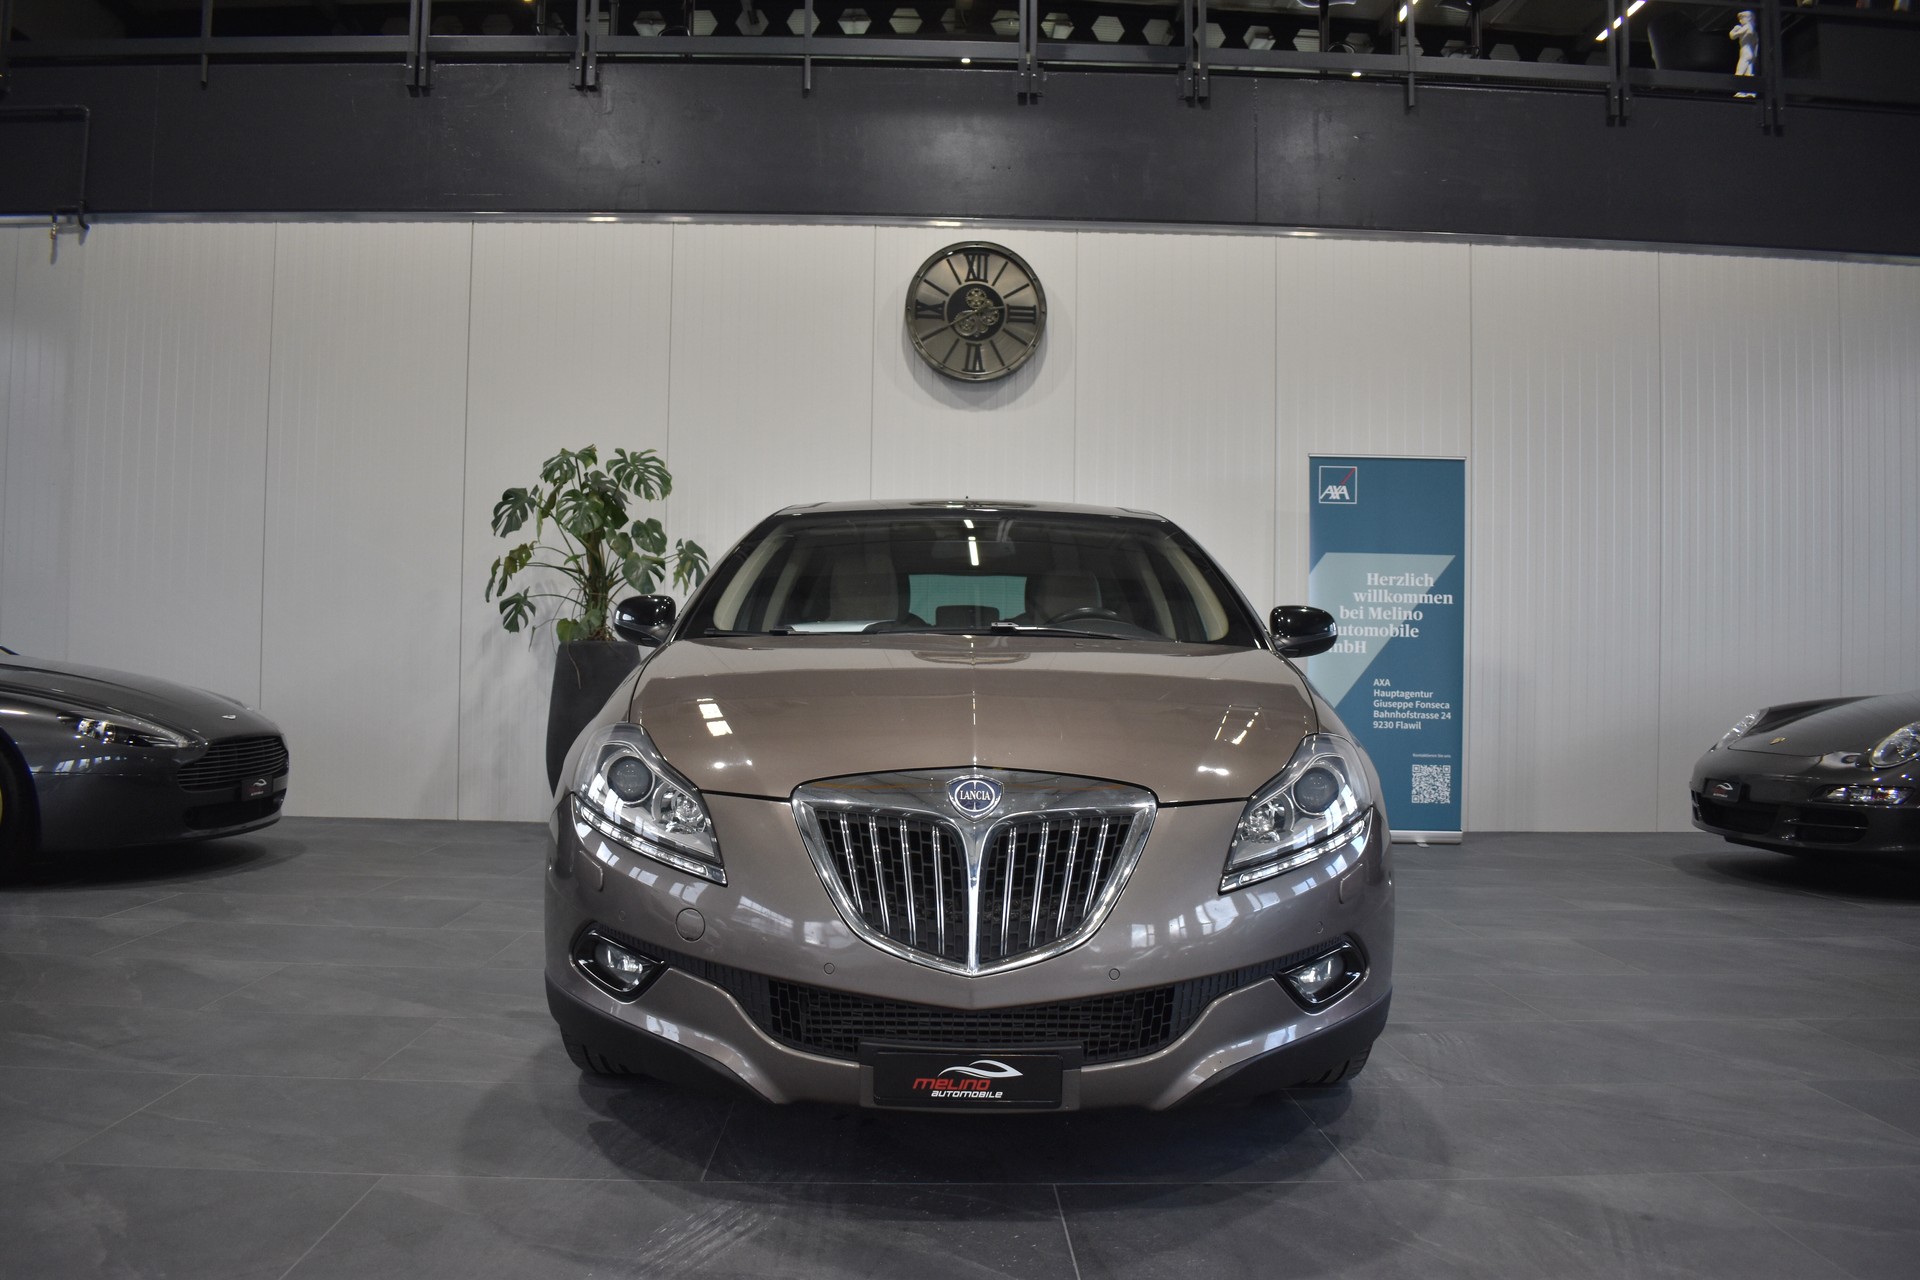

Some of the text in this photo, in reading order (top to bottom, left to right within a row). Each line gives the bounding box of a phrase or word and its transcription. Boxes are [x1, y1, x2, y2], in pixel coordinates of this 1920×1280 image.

[1320, 485, 1350, 500] AXA
[1366, 573, 1434, 587] Herzlich
[1353, 590, 1453, 604] willkommen
[1339, 606, 1423, 621] bei Melino
[1337, 623, 1420, 638] utomobile
[1373, 679, 1391, 687] AXA
[1373, 689, 1433, 700] Hauptagentur
[1373, 700, 1450, 710] Giuseppe Fonseca
[1373, 711, 1452, 720] Bahnhofstrasse 24
[1373, 721, 1422, 730] 9230 Flawil
[960, 790, 991, 801] LANCIA
